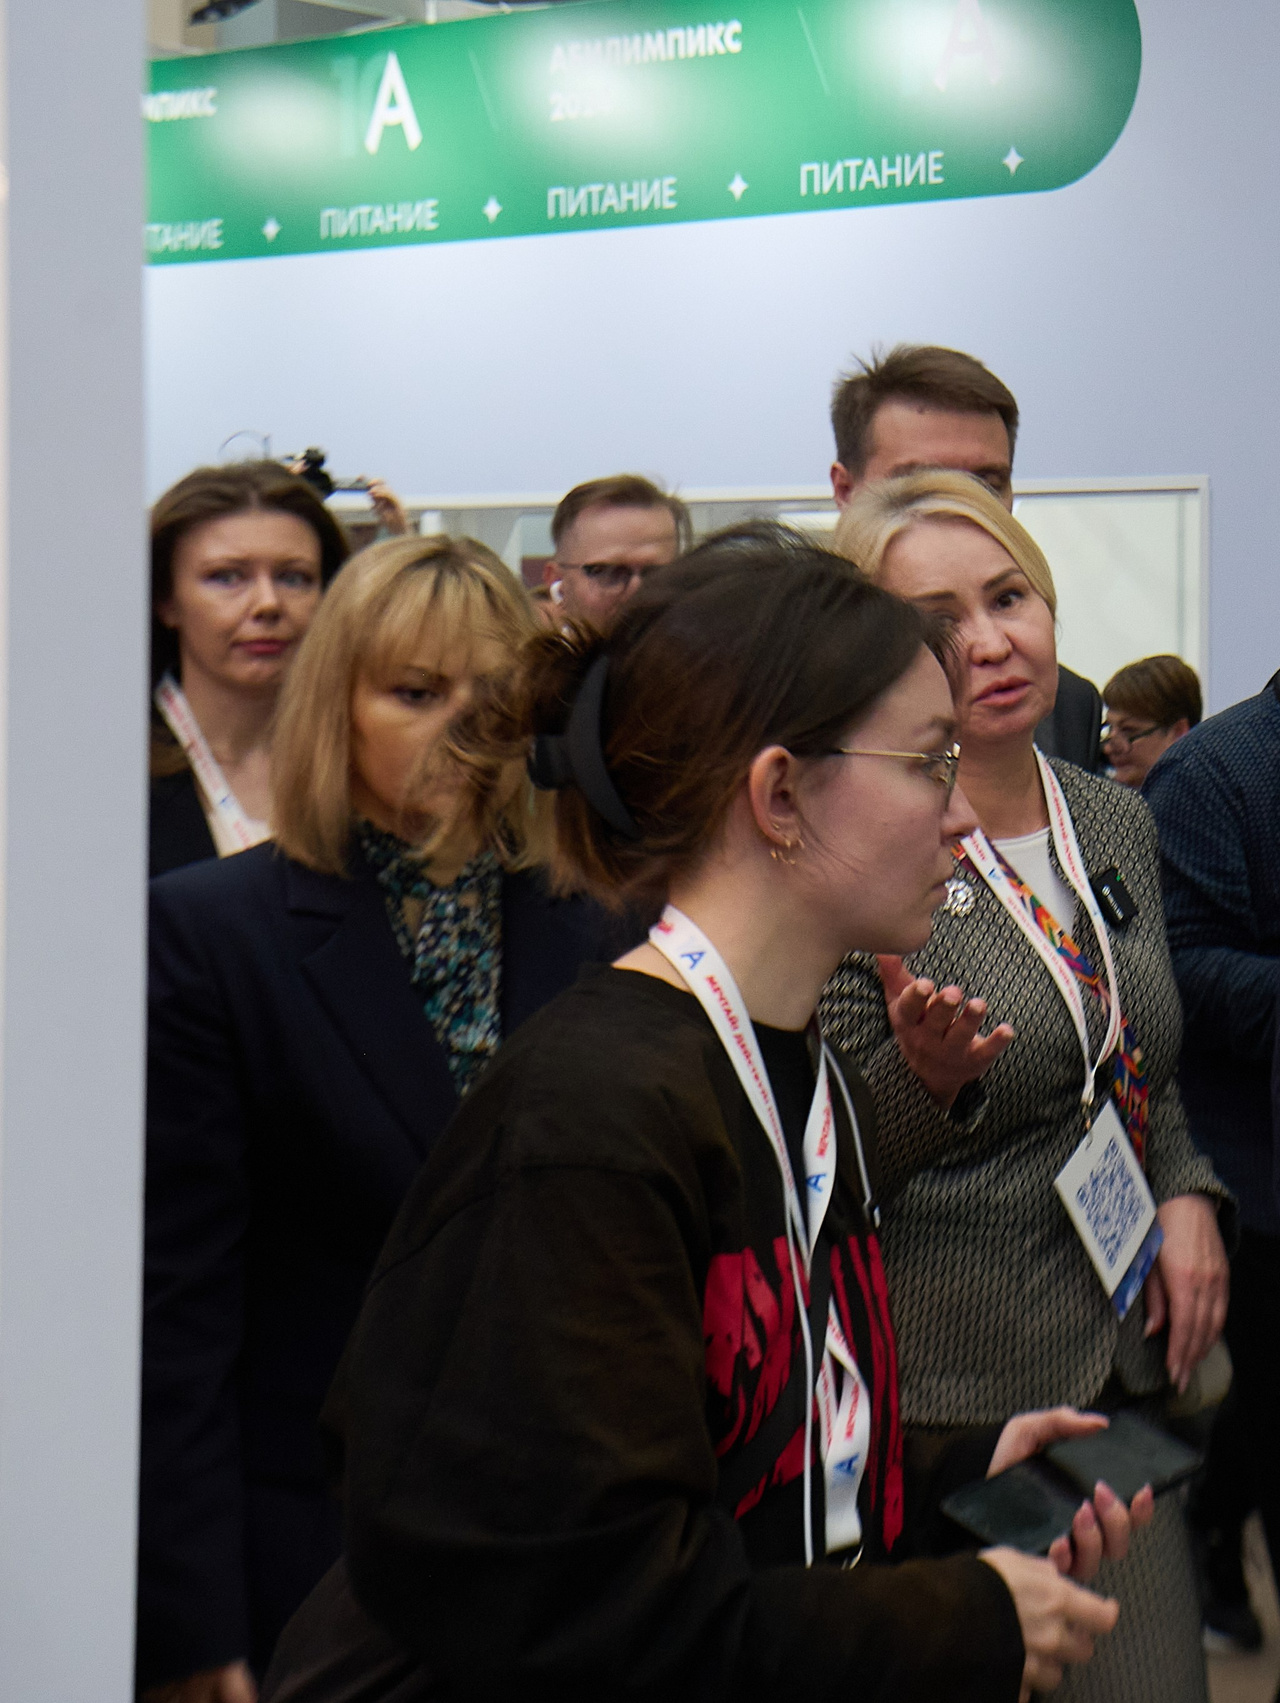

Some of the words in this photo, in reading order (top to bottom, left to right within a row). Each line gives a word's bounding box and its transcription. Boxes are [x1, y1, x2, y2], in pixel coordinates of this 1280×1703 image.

[550, 19, 742, 72] АБИЛИМПИКС
[800, 150, 944, 197] ПИТАНИЕ
[319, 198, 439, 240] ПИТАНИЕ
[547, 175, 677, 219] ПИТАНИЕ
